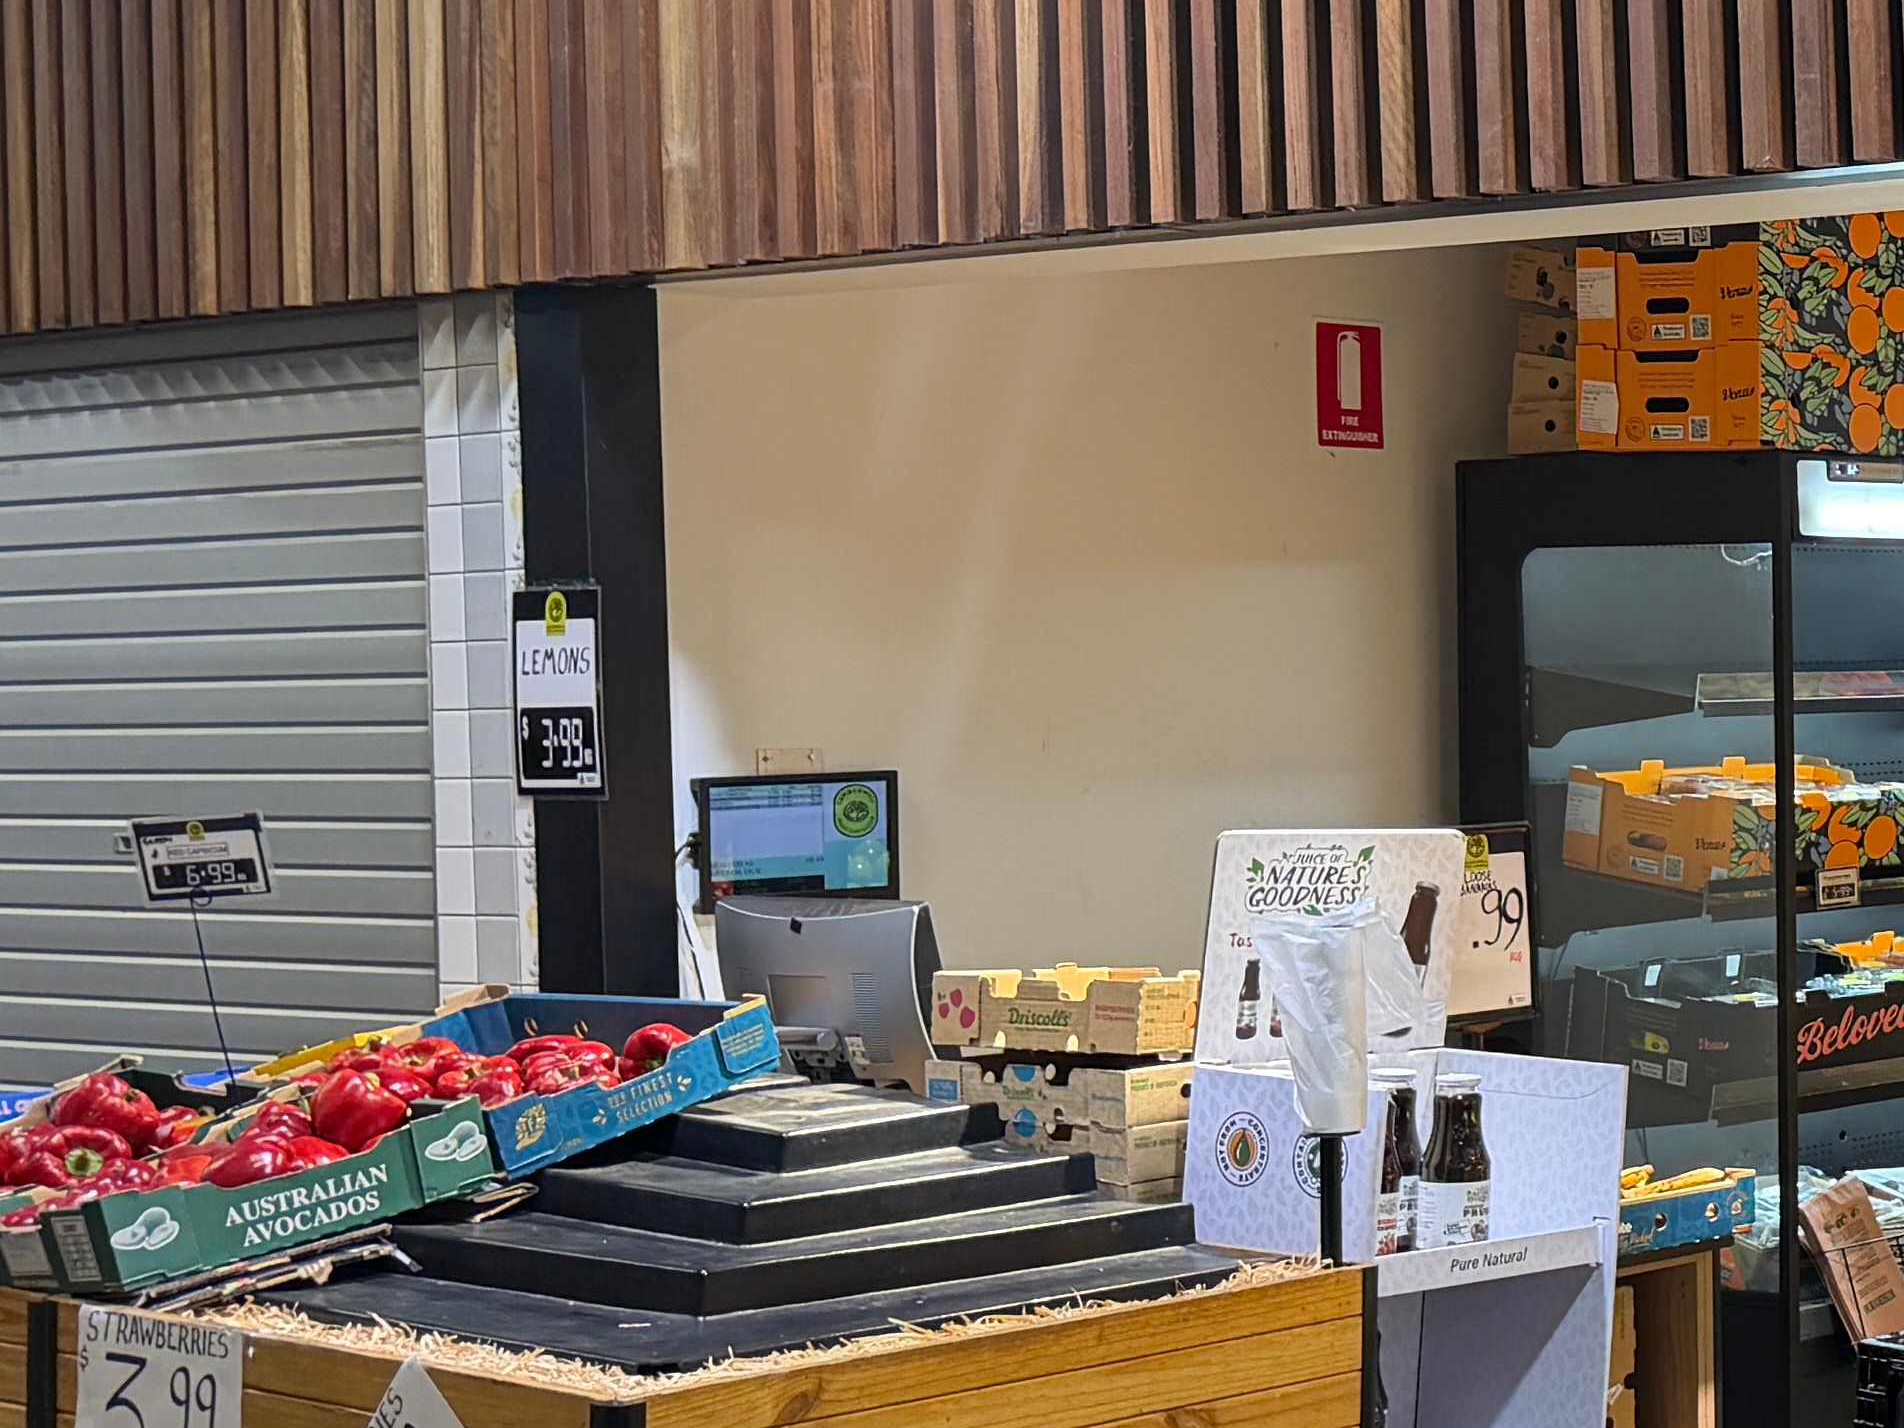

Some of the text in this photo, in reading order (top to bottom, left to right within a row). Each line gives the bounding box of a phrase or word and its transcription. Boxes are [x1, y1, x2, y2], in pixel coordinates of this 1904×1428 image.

[1340, 415, 1359, 427] FIRE
[1322, 429, 1378, 444] EXTINGUISHER
[521, 646, 590, 675] LEMONS
[542, 718, 583, 768] 3.99
[1294, 851, 1344, 865] JUICE OF
[186, 862, 235, 885] 6.99
[1249, 885, 1361, 908] GOODNESS
[1229, 932, 1253, 949] Tas
[630, 1072, 673, 1101] FINEST
[616, 1092, 672, 1123] SELECTION
[225, 1164, 389, 1227] AUSTRALIAN
[243, 1190, 380, 1247] AVOCADOS
[1451, 1247, 1528, 1272] Pure Natural
[87, 1311, 229, 1359] STRAWBERRIES
